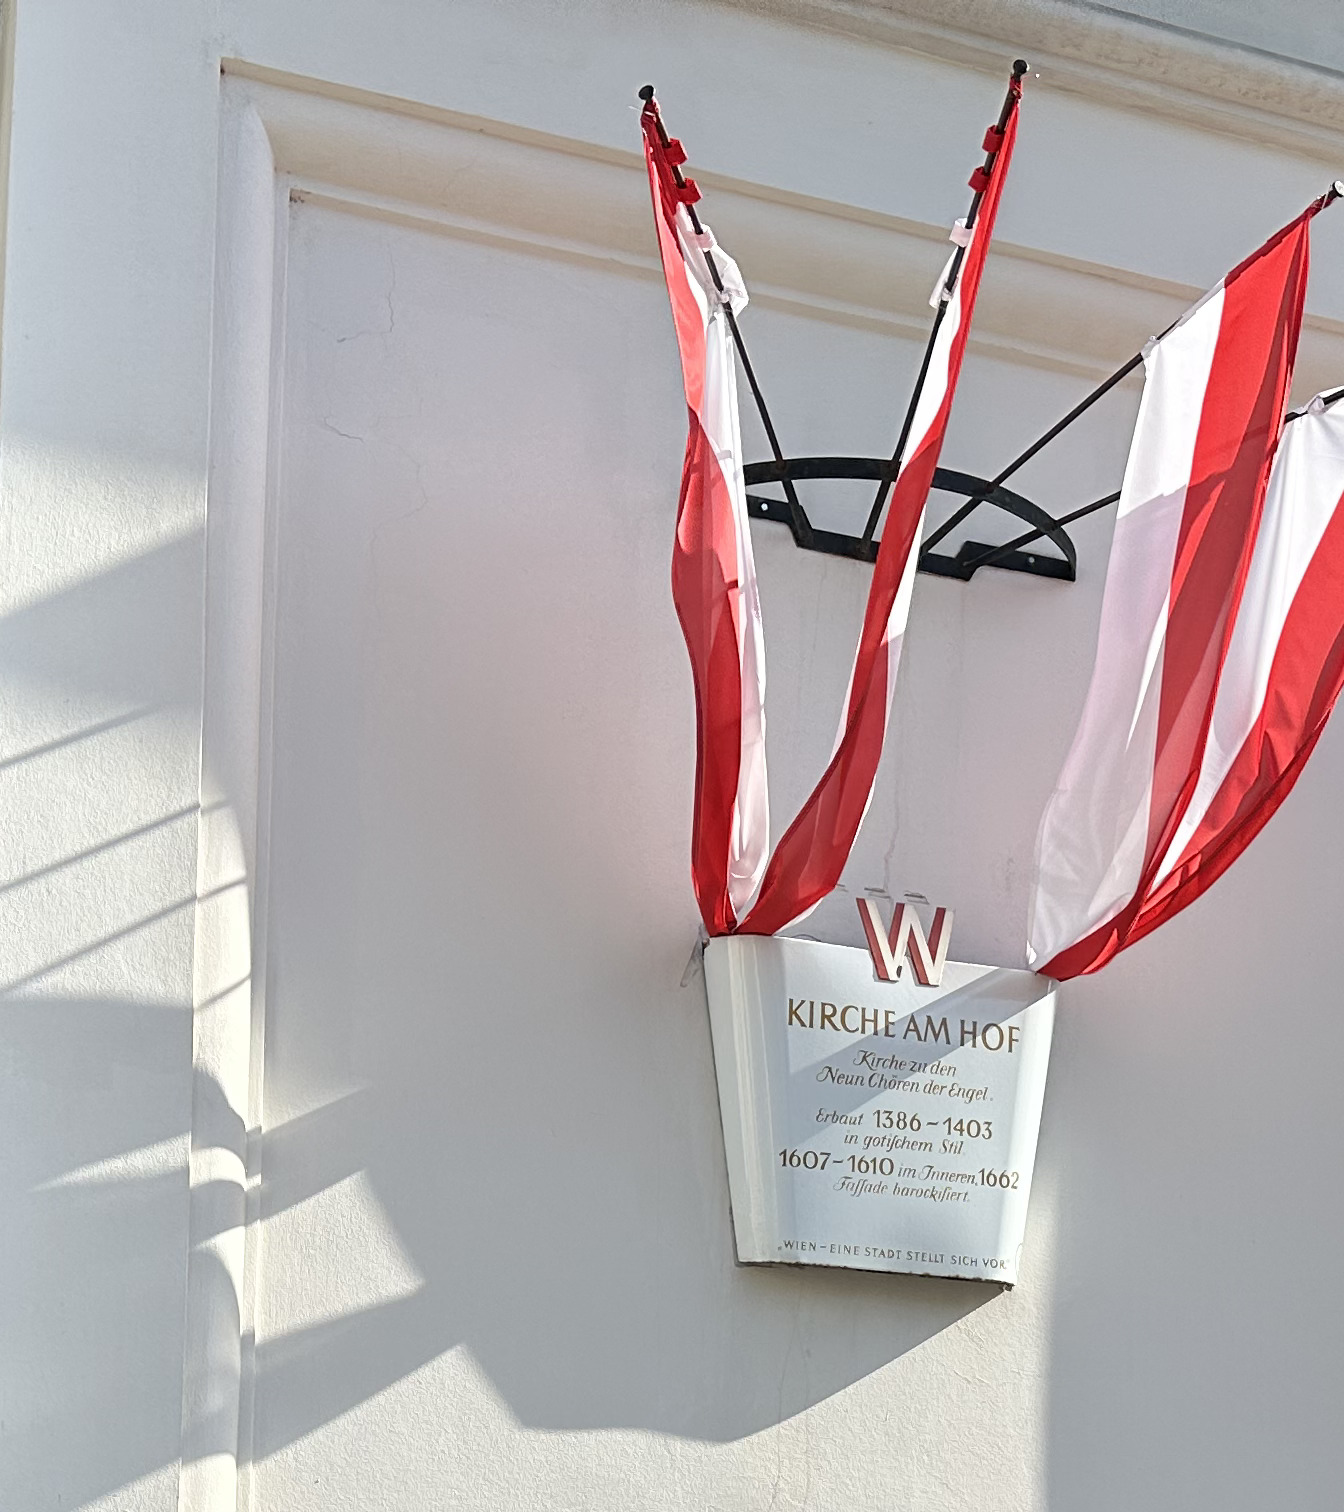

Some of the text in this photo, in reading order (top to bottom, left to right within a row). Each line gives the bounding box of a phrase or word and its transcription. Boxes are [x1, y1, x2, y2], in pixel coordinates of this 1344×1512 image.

[856, 897, 955, 986] W
[787, 998, 1021, 1053] KIRCHE AM HOF
[853, 1049, 957, 1077] Kirche zu den
[815, 1065, 865, 1087] Neun
[868, 1072, 920, 1093] Chören
[923, 1078, 947, 1096] der
[815, 1107, 865, 1126] Erbaut
[843, 1130, 859, 1145] in
[897, 1162, 916, 1178] im
[978, 1167, 1020, 1190] 1662
[829, 1243, 860, 1256] EINE
[864, 1246, 902, 1260] STADT
[906, 1250, 945, 1264] STELLT
[950, 1254, 978, 1268] SICH
